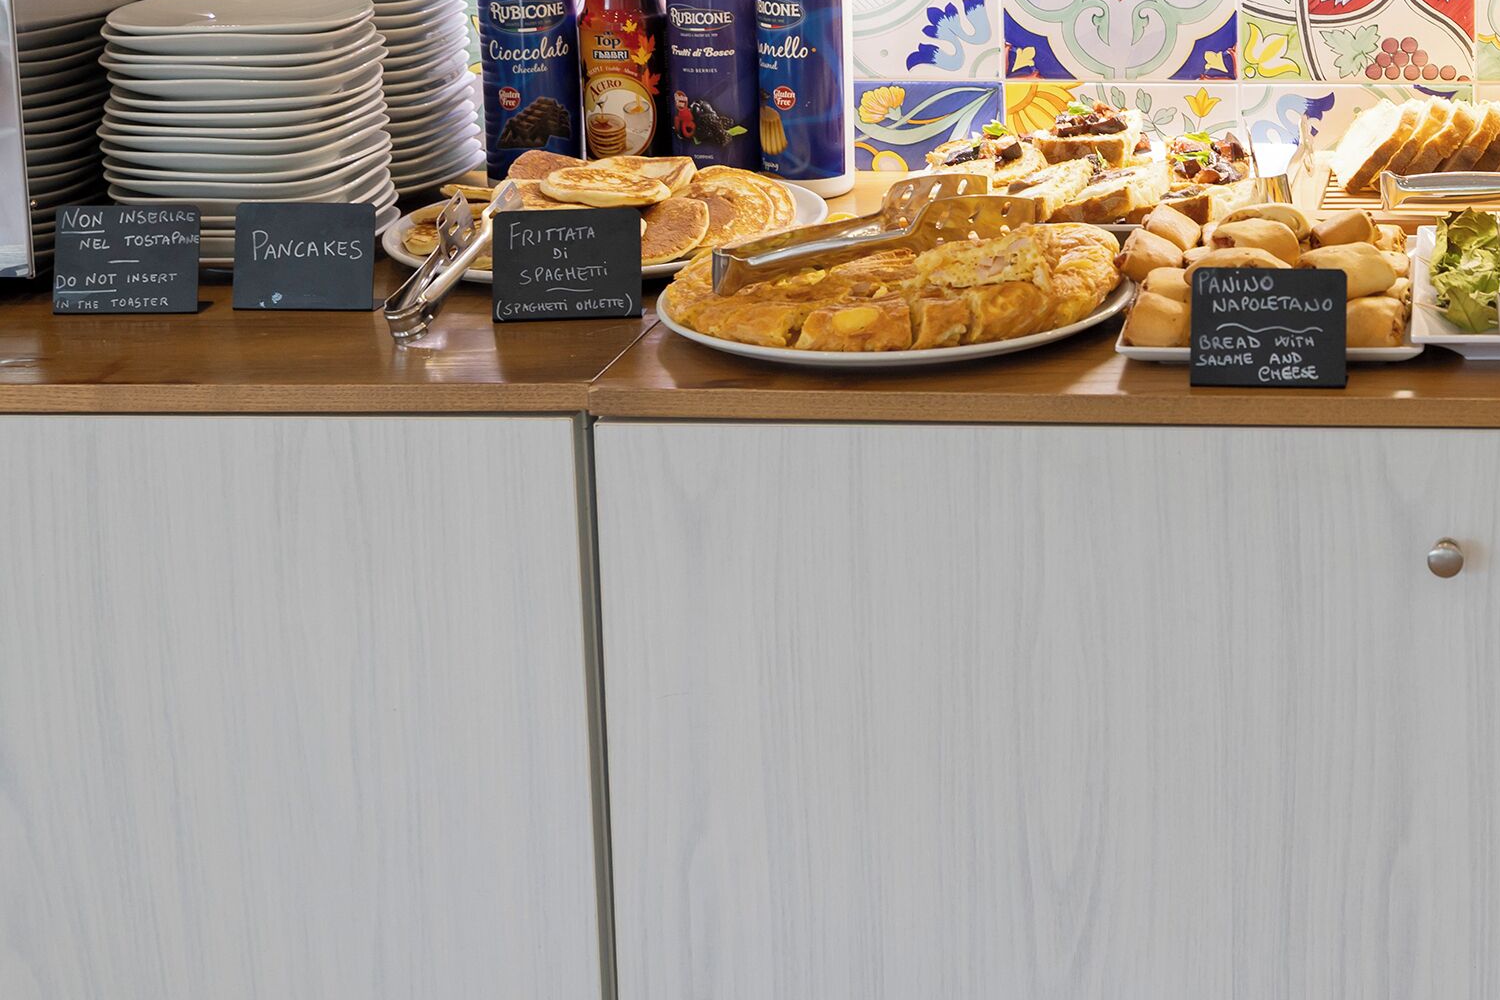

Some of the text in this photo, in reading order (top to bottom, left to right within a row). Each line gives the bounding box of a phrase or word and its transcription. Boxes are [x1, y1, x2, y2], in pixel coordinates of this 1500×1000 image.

[490, 1, 564, 23] RUBICONE
[671, 7, 732, 26] RUBICONE
[489, 35, 569, 61] Cioccolato
[593, 34, 621, 49] Top
[593, 51, 628, 59] FABBRI
[671, 45, 736, 57] Frutti di Bosco
[512, 63, 548, 74] Chocolate
[590, 80, 622, 101] ACERO
[773, 89, 796, 100] Gluten
[61, 208, 195, 230] NON INSERIRE
[80, 231, 200, 250] NEL TOSTAPANE
[510, 222, 596, 250] FRITTATA
[251, 229, 363, 261] PANCAKES
[56, 272, 178, 289] DO NOT INSERT
[56, 296, 169, 309] IN THE TOASTER
[576, 293, 633, 316] OMLETTE)
[1212, 296, 1333, 313] NAPOLETANO
[1199, 335, 1261, 350] BREAD
[1195, 352, 1302, 366] SALAME AND
[1258, 366, 1319, 382] CHEESE
